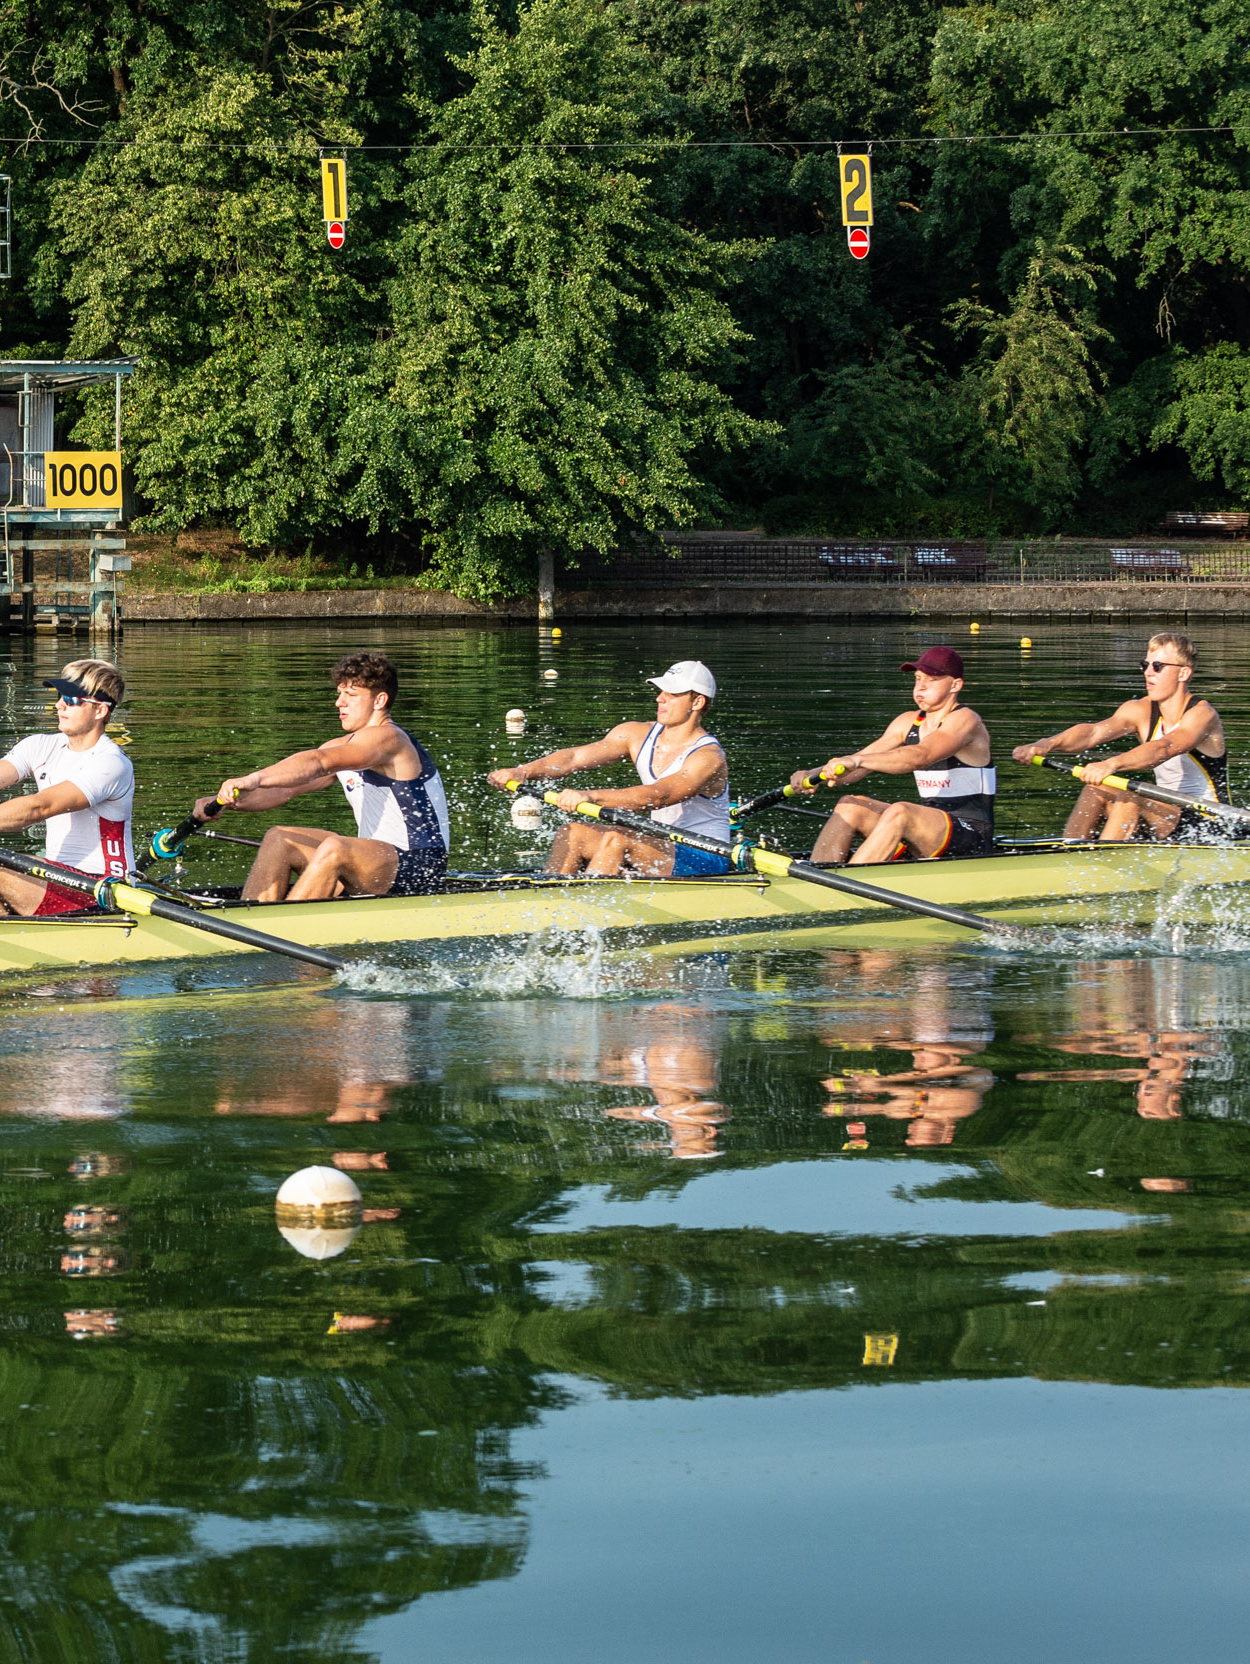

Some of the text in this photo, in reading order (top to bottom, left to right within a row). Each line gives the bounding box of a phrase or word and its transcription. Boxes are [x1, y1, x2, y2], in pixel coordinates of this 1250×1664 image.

[328, 163, 340, 218] 1
[845, 158, 868, 222] 2
[48, 463, 118, 497] 1000
[682, 837, 717, 852] concept
[44, 871, 88, 890] concept 2
